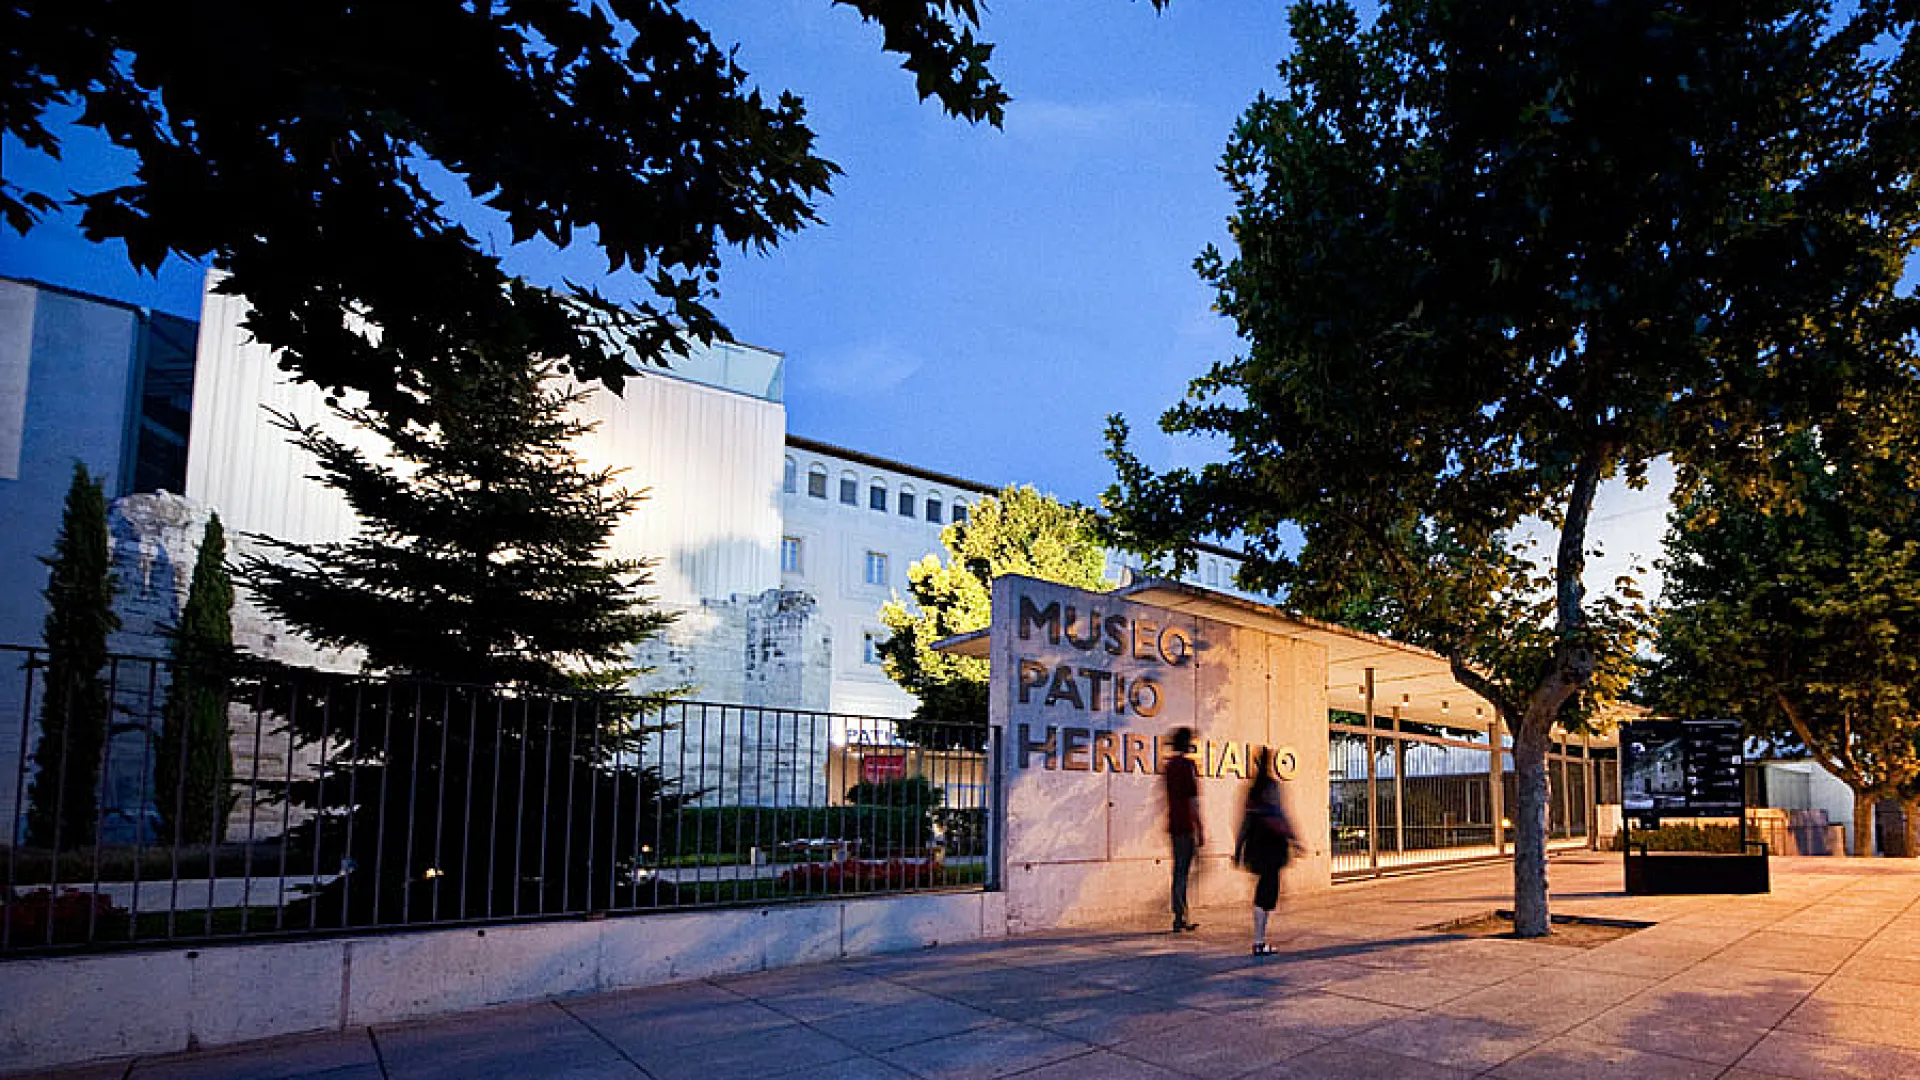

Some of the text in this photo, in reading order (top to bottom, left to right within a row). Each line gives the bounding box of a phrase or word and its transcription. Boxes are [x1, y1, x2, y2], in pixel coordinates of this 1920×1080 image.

[1018, 595, 1191, 665] MUSEO
[1018, 658, 1164, 717] PATIO
[846, 728, 897, 745] PATI
